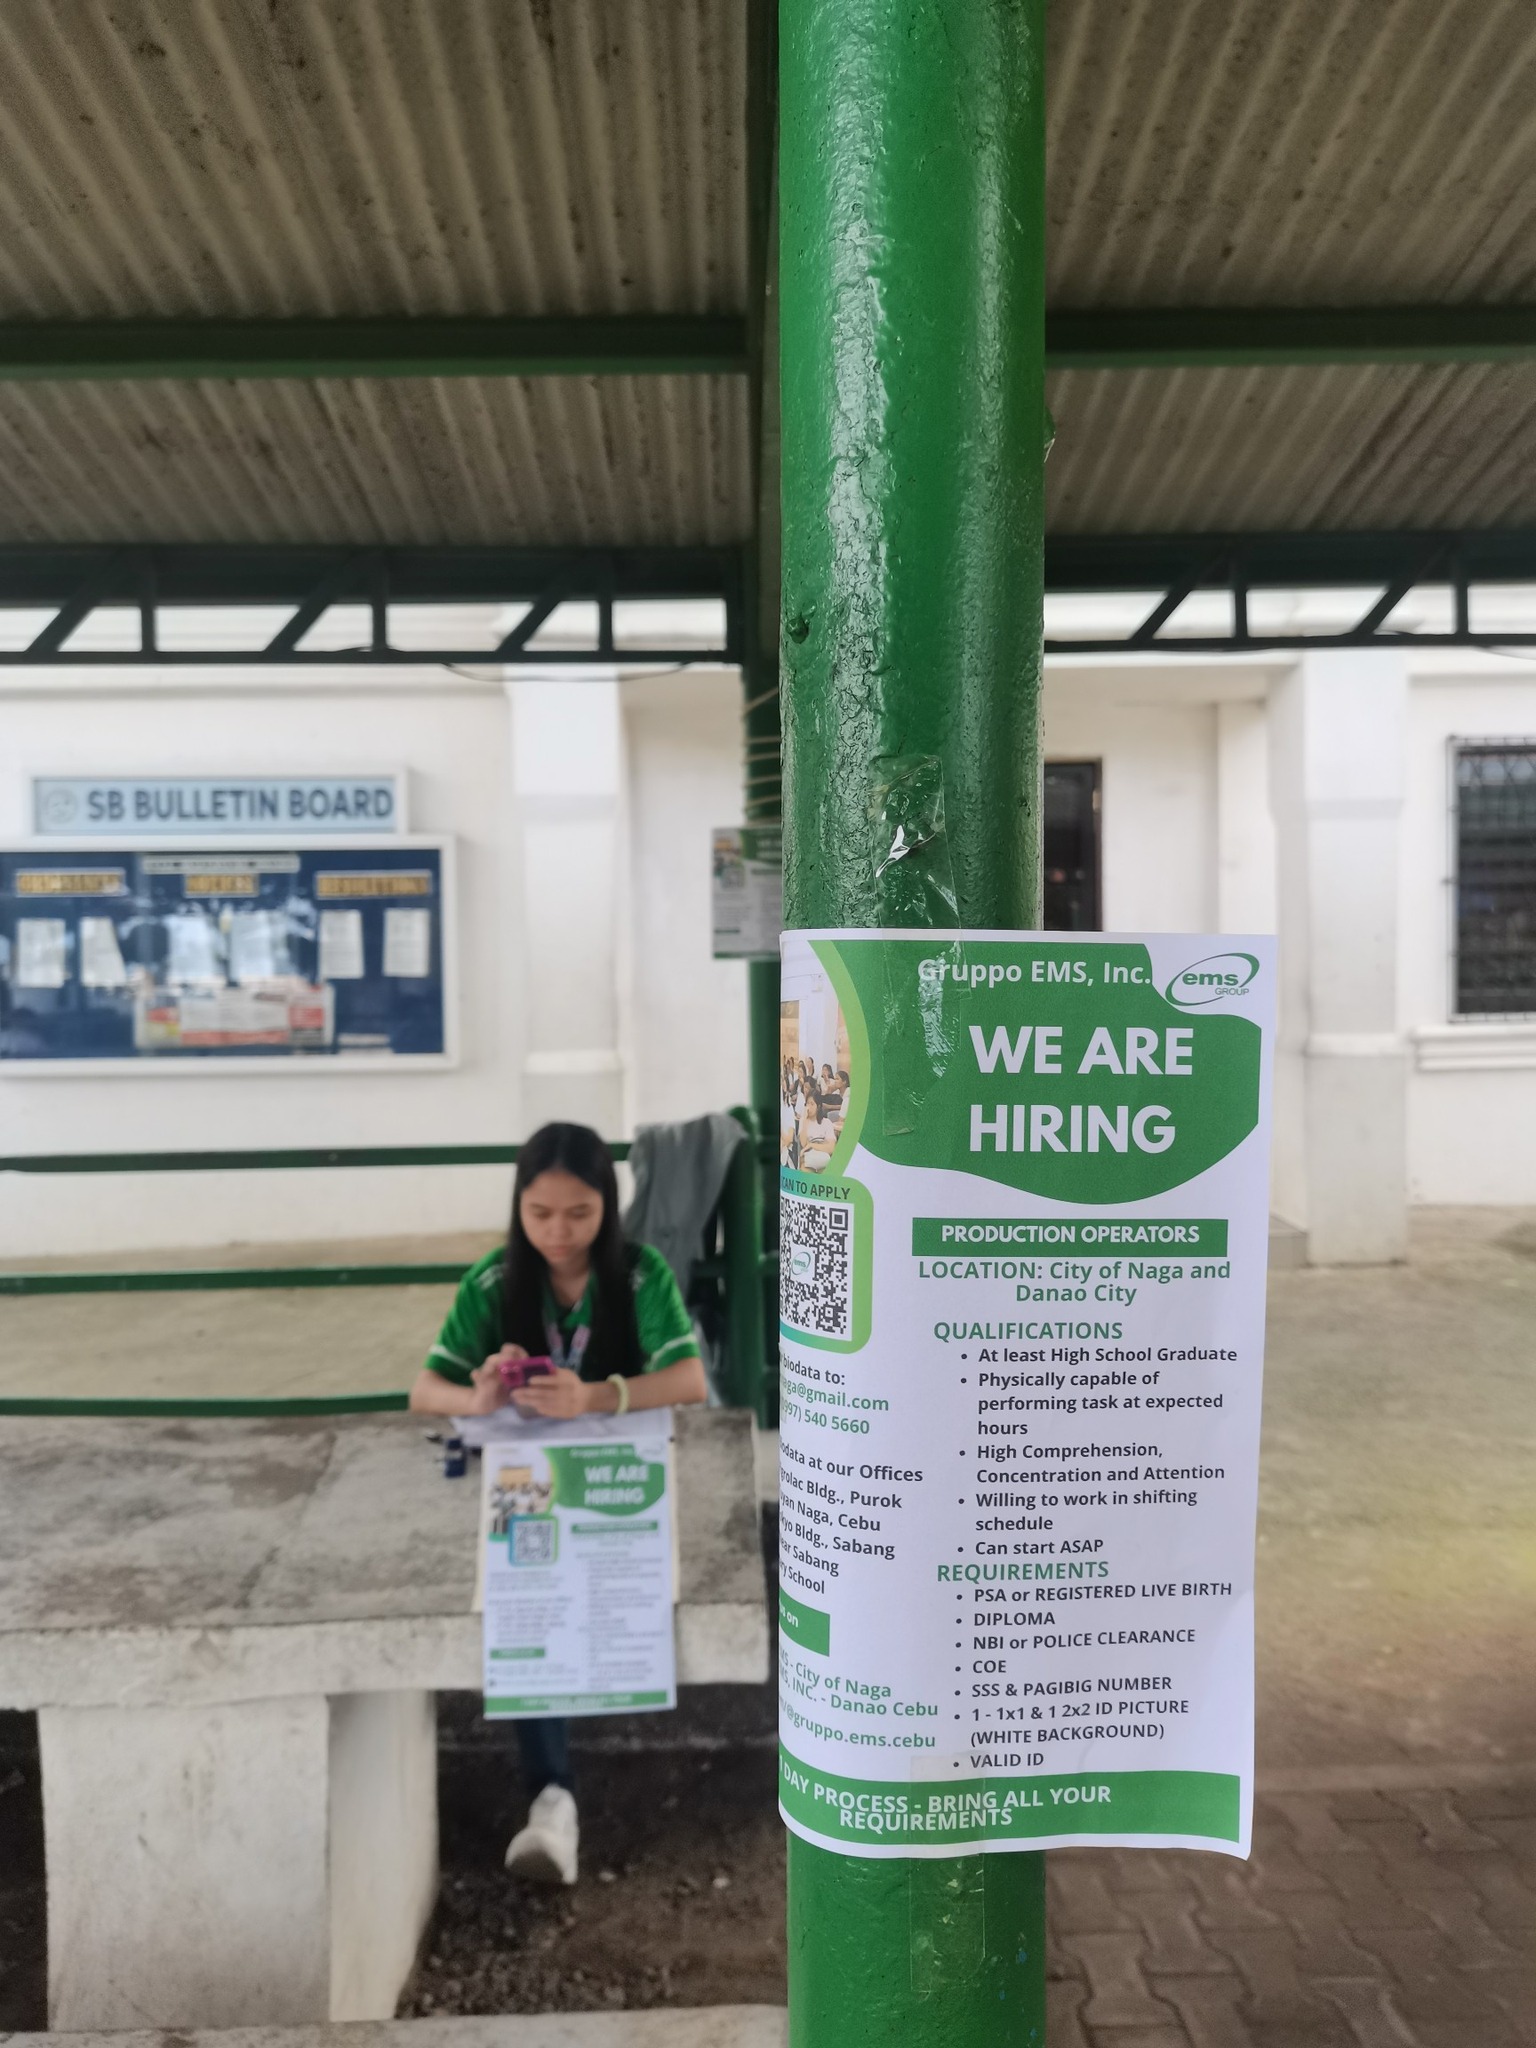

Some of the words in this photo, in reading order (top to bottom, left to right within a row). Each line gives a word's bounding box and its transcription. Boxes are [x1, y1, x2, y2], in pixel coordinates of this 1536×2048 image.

[87, 789, 124, 821] SB
[134, 789, 279, 821] BULLETIN
[289, 789, 393, 820] BOARD
[917, 959, 1021, 988] Gruppo
[1031, 960, 1093, 986] EMS,
[1104, 961, 1151, 984] Inc.
[1182, 971, 1238, 986] ems
[1215, 987, 1249, 996] GROUP
[968, 1025, 1063, 1074] WE
[1077, 1027, 1194, 1076] ARE
[969, 1104, 1176, 1154] HIRING
[796, 1180, 807, 1194] TO
[810, 1184, 850, 1200] APPLY
[941, 1225, 1075, 1243] PRODUCTION
[1081, 1225, 1200, 1244] OPERATORS
[919, 1261, 1043, 1279] LOCATION:
[1050, 1261, 1092, 1284] City
[1099, 1261, 1122, 1279] of
[1127, 1262, 1183, 1284] Naga
[1190, 1261, 1230, 1279] and
[1016, 1284, 1086, 1302] Danao
[1094, 1285, 1137, 1306] City
[934, 1322, 1123, 1343] QUALIFICATIONS
[978, 1348, 998, 1362] At
[1003, 1348, 1045, 1362] least
[1051, 1348, 1090, 1365] High
[1095, 1347, 1151, 1362] School
[1157, 1347, 1237, 1362] Graduate
[783, 1354, 820, 1380] biodata
[825, 1370, 846, 1385] to:
[979, 1372, 1065, 1390] Physically
[1070, 1372, 1137, 1389] capable
[1142, 1371, 1160, 1385] of
[781, 1377, 889, 1411] aga@gmail.com
[978, 1396, 1077, 1414] performing
[1082, 1396, 1118, 1409] task
[1123, 1396, 1140, 1409] at
[1145, 1394, 1223, 1411] expected
[805, 1409, 827, 1428] 540
[832, 1417, 869, 1434] 5660
[978, 1420, 1028, 1435] hours
[780, 1441, 804, 1465] odata
[809, 1457, 822, 1471] at
[827, 1462, 854, 1476] our
[860, 1465, 923, 1482] Offices
[977, 1445, 1016, 1463] High
[1022, 1443, 1163, 1461] Comprehension,
[976, 1468, 1101, 1483] Concentration
[1107, 1467, 1138, 1481] and
[1144, 1465, 1225, 1480] Attention
[781, 1467, 803, 1491] grolac
[807, 1481, 844, 1504] Bldg.,
[850, 1491, 902, 1508] Purok
[976, 1492, 1036, 1510] Willing
[1041, 1494, 1058, 1506] to
[1064, 1492, 1108, 1506] work
[1112, 1491, 1128, 1504] in
[1133, 1489, 1197, 1506] shifting
[798, 1501, 833, 1526] Naga,
[838, 1514, 881, 1531] Cebu
[975, 1516, 1053, 1531] schedule
[795, 1523, 828, 1549] Bldg.,
[833, 1537, 895, 1560] Sabang
[975, 1541, 1008, 1555] Can
[1013, 1541, 1055, 1554] start
[1060, 1539, 1104, 1553] ASAP
[793, 1545, 839, 1577] Sabang
[788, 1569, 825, 1594] School
[938, 1561, 1109, 1584] REQUIREMENTS
[974, 1589, 1007, 1602] PSA
[1012, 1591, 1031, 1601] or
[1036, 1585, 1135, 1601] REGISTERED
[1142, 1584, 1176, 1597] LIVE
[1182, 1582, 1232, 1596] BIRTH
[787, 1613, 798, 1628] on
[974, 1612, 1055, 1626] DIPLOMA
[973, 1636, 1004, 1650] NBI
[1009, 1637, 1028, 1649] or
[1033, 1633, 1092, 1648] POLICE
[1097, 1629, 1196, 1645] CLEARANCE
[972, 1660, 1007, 1674] COE
[796, 1663, 819, 1687] City
[824, 1677, 840, 1690] of
[846, 1680, 891, 1700] Naga
[972, 1684, 1000, 1698] SSS
[1005, 1682, 1018, 1696] &
[1023, 1680, 1092, 1696] PAGIBIG
[1097, 1677, 1172, 1692] NUMBER
[793, 1678, 817, 1702] INC.
[831, 1695, 887, 1715] Danao
[893, 1702, 938, 1716] Cebu
[972, 1708, 980, 1721] 1
[996, 1706, 1024, 1720] 1x1
[1031, 1705, 1043, 1719] &
[1050, 1705, 1056, 1718] 1
[1062, 1703, 1091, 1718] 2x2
[1096, 1703, 1113, 1716] ID
[1119, 1700, 1189, 1715] PICTURE
[971, 1730, 1032, 1748] (WHITE
[1038, 1724, 1164, 1742] BACKGROUND)
[970, 1754, 1021, 1769] VALID
[1027, 1753, 1044, 1766] ID
[784, 1762, 809, 1794] DAY
[814, 1783, 908, 1813] PROCESS
[928, 1791, 998, 1814] BRING
[1003, 1790, 1043, 1808] ALL
[1049, 1786, 1111, 1805] YOUR
[839, 1808, 1013, 1835] REQUIREMENTS
